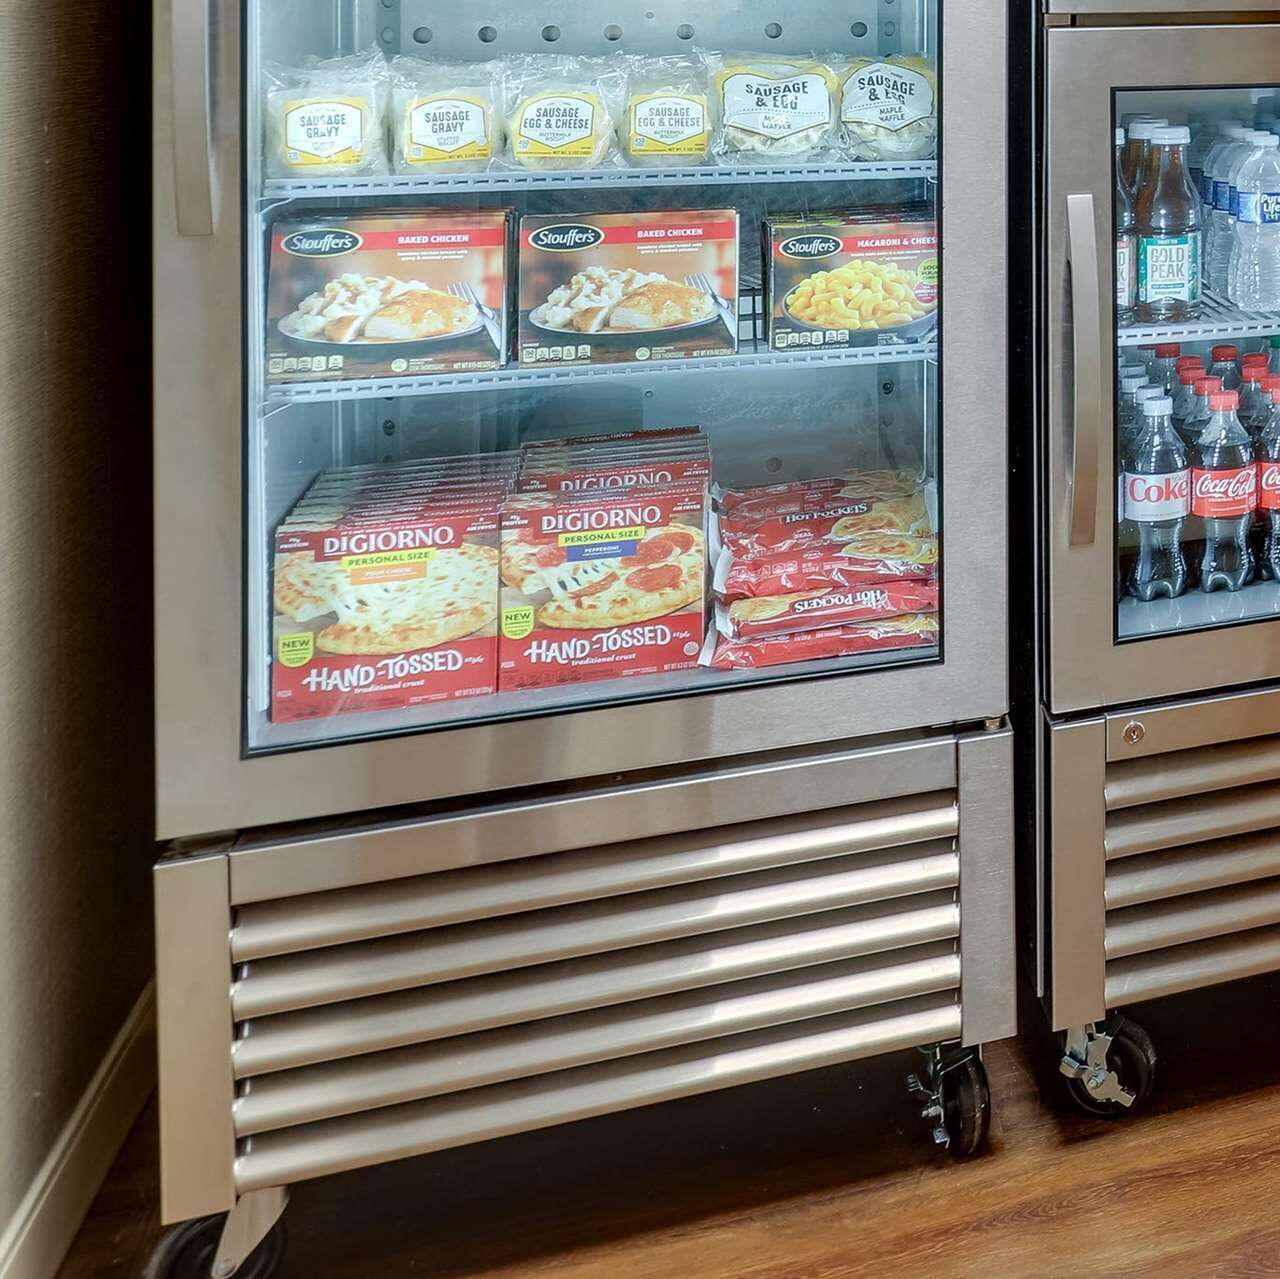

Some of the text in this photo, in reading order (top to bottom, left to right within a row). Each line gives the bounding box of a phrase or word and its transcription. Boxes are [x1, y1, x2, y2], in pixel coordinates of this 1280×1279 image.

[744, 81, 810, 97] SAUSAGE
[856, 76, 916, 96] SAUSAGE
[868, 87, 880, 101] &
[756, 94, 769, 109] &
[424, 110, 471, 123] SAUSAGE
[535, 106, 580, 118] SAUSAGE
[648, 106, 691, 118] SAUSAGE
[879, 106, 903, 116] MAPLE
[299, 114, 347, 127] SAUSAGE
[523, 117, 590, 130] EGG & CHEESE
[638, 116, 701, 128] EGG CHEESE
[431, 121, 466, 134] GRAVY
[1262, 202, 1280, 214] Life
[398, 234, 470, 246] BAKED CHICKEN
[537, 228, 596, 247] Stouffer's
[637, 228, 704, 239] BAKED CHICKEN
[291, 233, 354, 253] Stouffer's
[786, 238, 837, 255] Stouffer's
[856, 238, 901, 249] MACARONI
[1150, 247, 1184, 263] GOLD
[1151, 263, 1185, 279] PEAK
[563, 528, 640, 545] PERSONAL SIZE
[584, 545, 620, 554] PEPPERONI
[347, 550, 431, 567] PERSONAL SIZE
[794, 594, 854, 614] POCKETS
[504, 611, 532, 622] NEW
[281, 638, 311, 650] NEW
[523, 624, 672, 665] HAND-TOSSED
[571, 652, 637, 667] traditional crust
[301, 649, 465, 694] HAND-TOSSED
